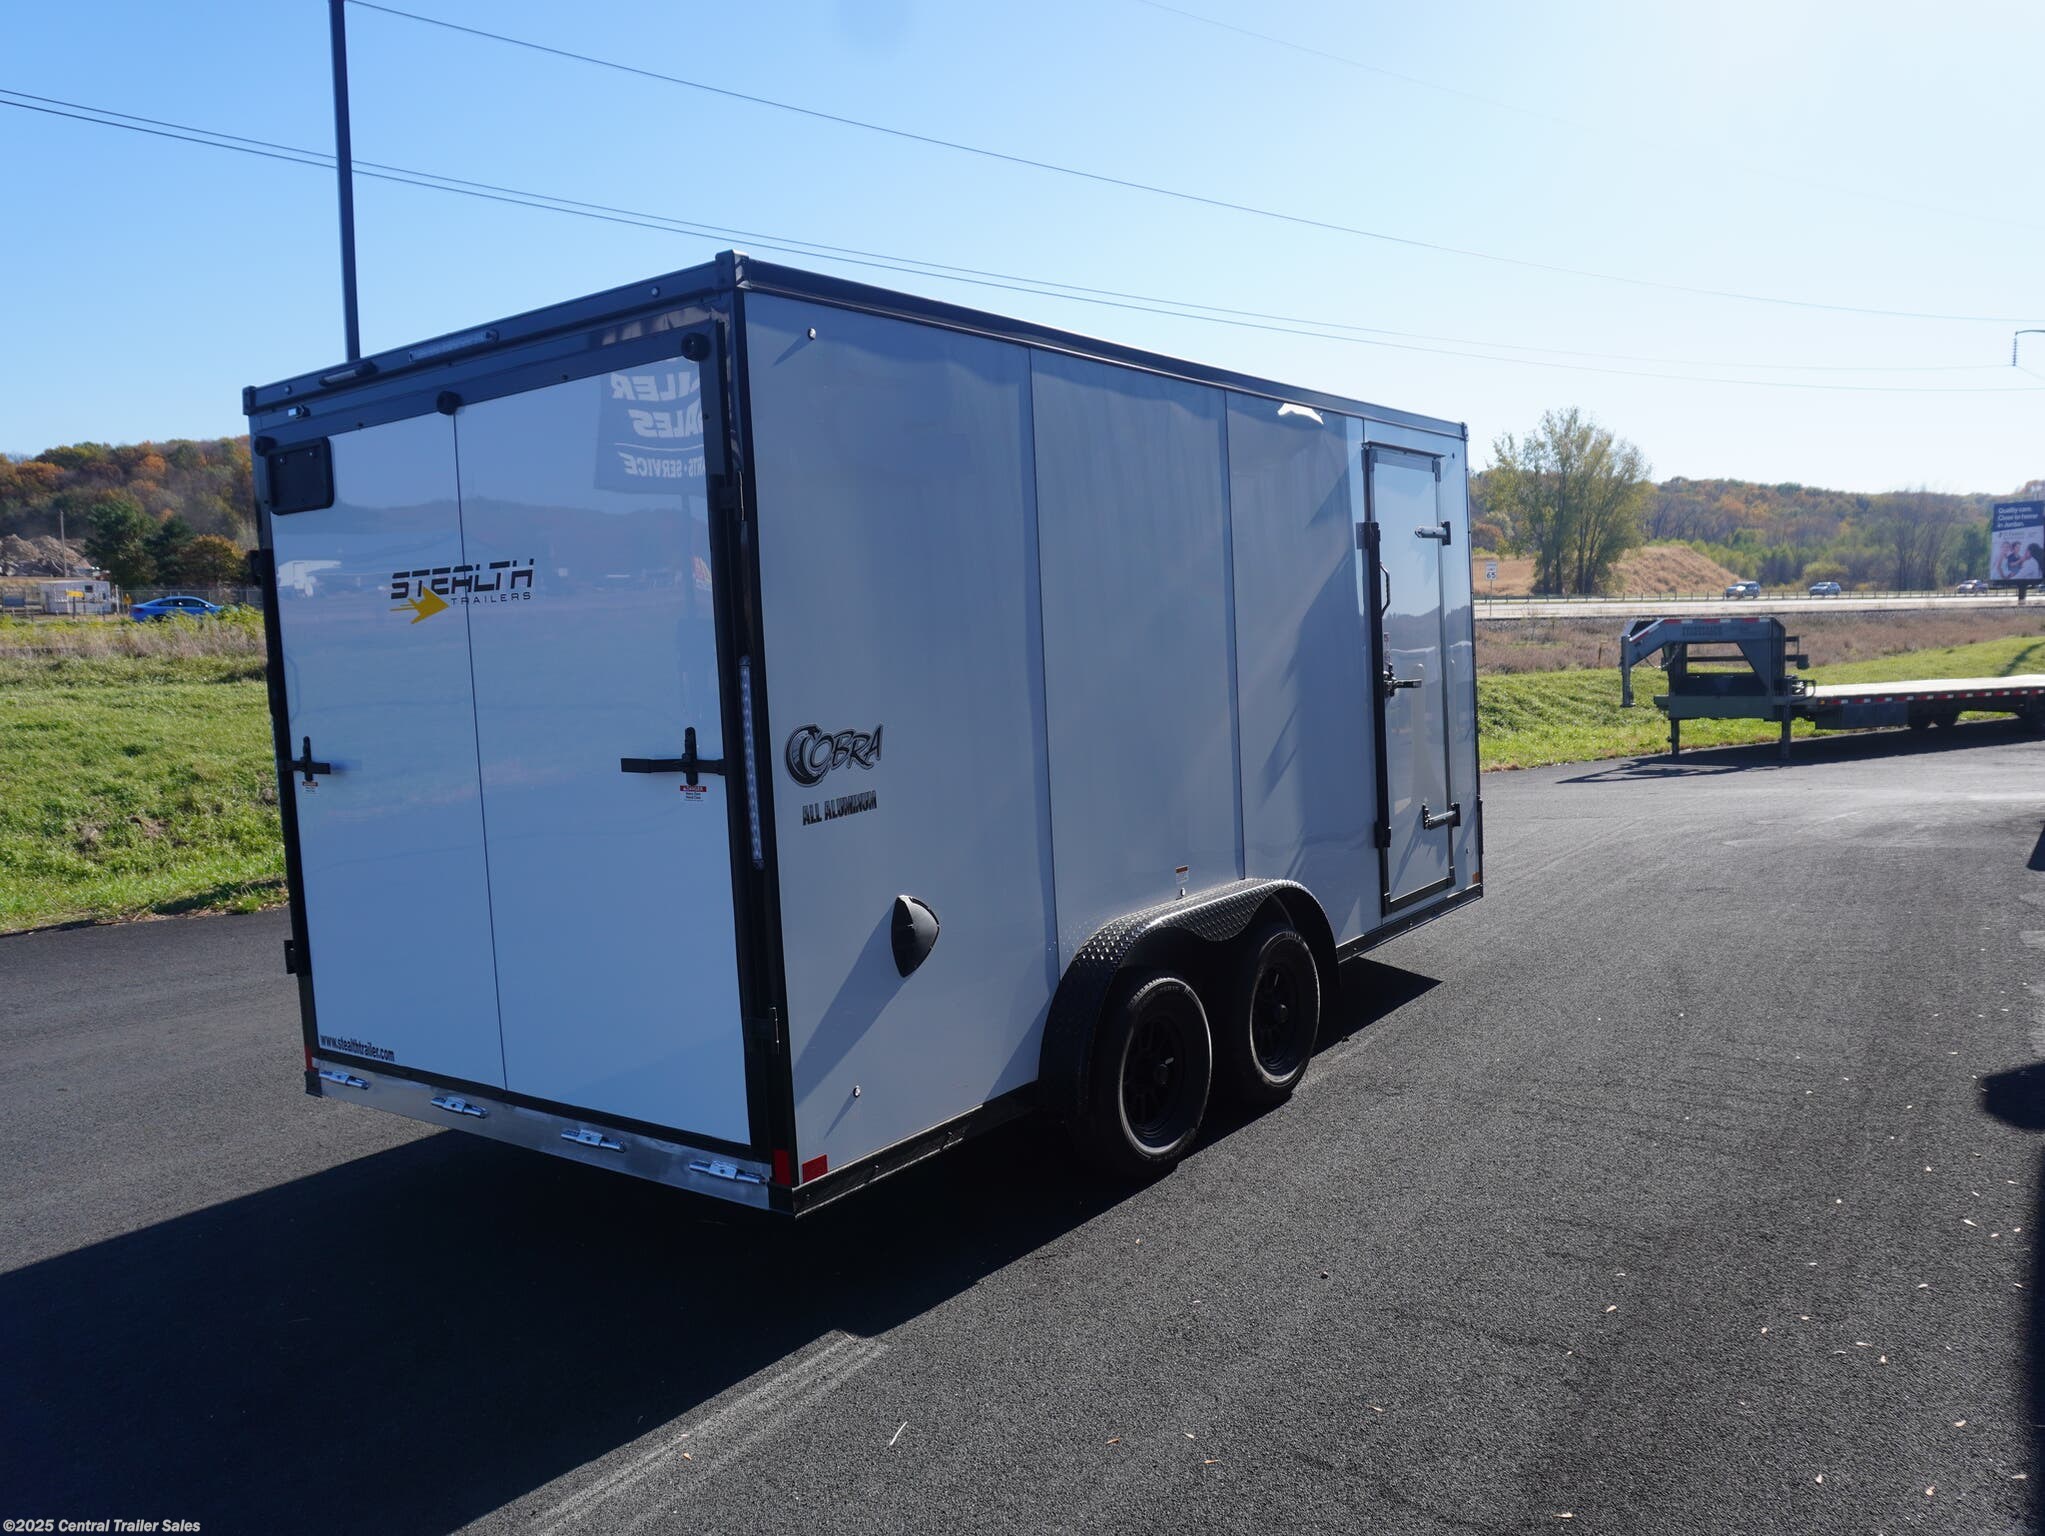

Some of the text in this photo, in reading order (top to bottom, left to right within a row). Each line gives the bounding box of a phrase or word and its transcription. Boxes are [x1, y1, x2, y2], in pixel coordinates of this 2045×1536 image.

[391, 558, 534, 599] STEALTH
[1486, 571, 1496, 579] 65
[450, 591, 531, 606] TRAILERS
[802, 790, 877, 826] ALL ALUMINUM
[320, 1035, 395, 1062] www.stealthtrailer.com
